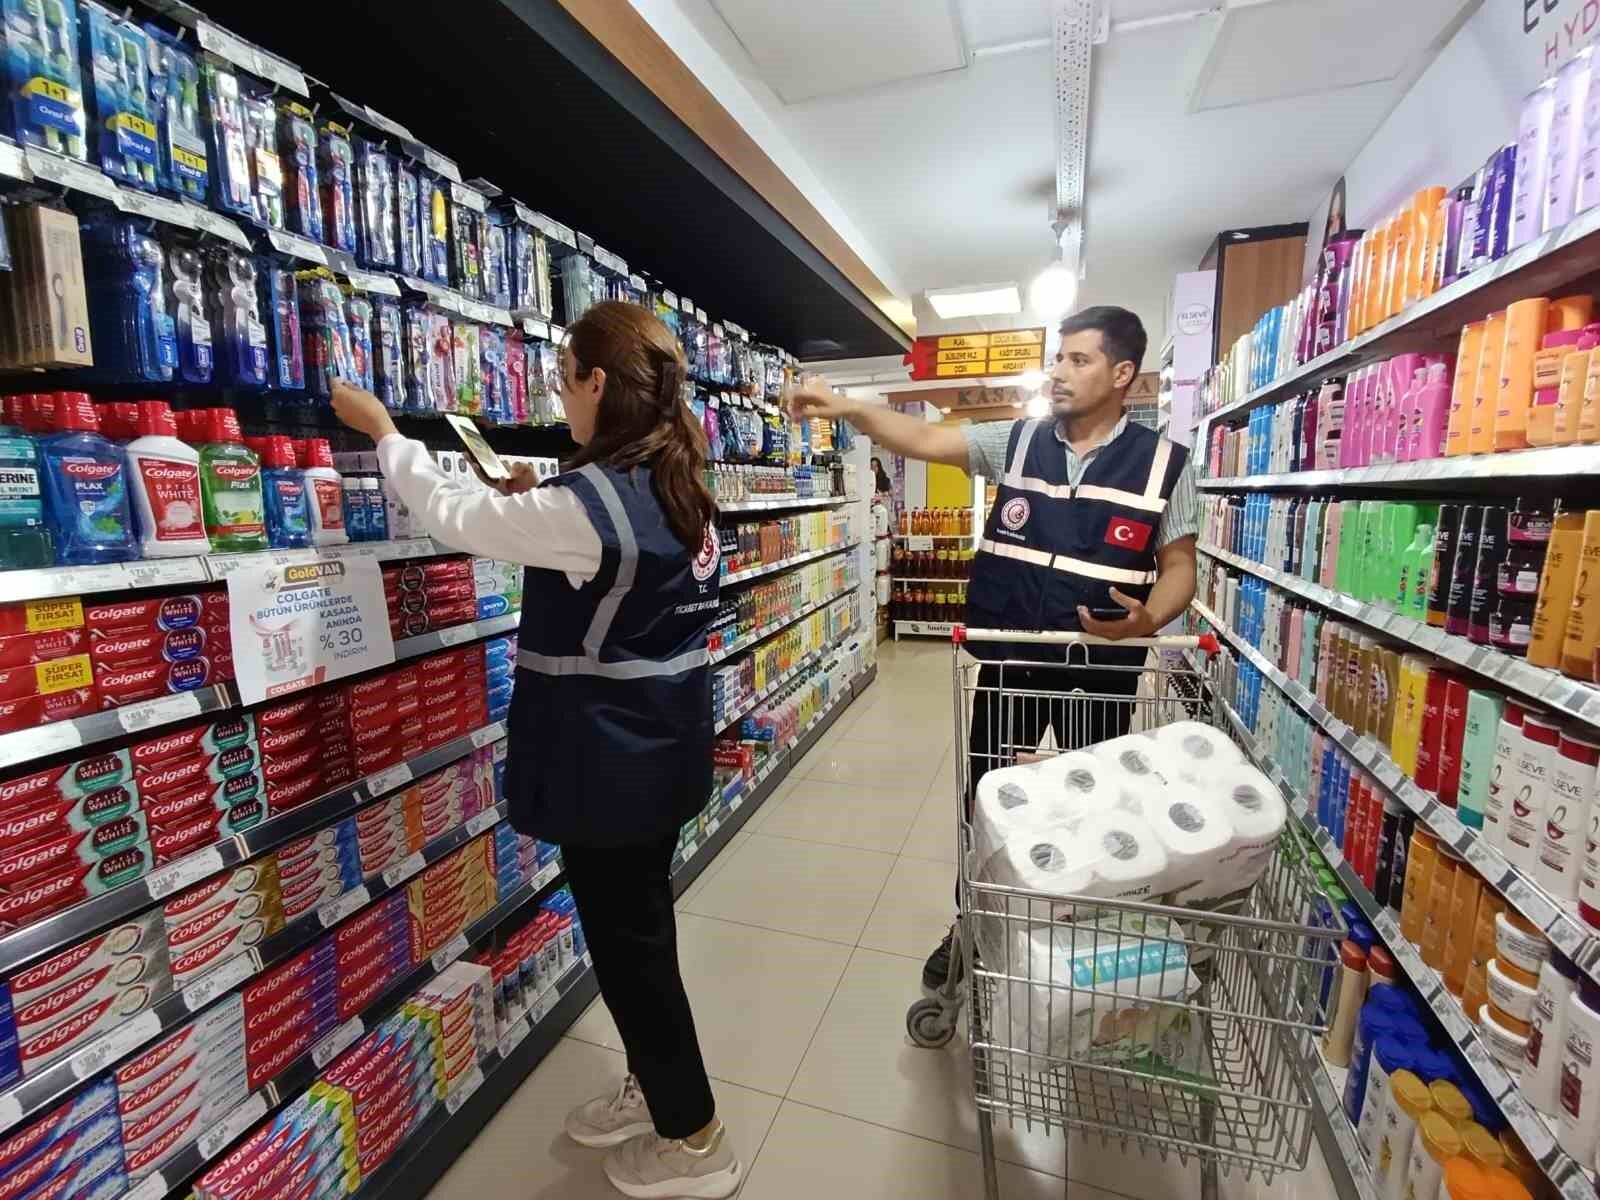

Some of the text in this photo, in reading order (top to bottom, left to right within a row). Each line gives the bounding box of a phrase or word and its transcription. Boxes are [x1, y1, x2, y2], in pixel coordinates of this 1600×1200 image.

[41, 81, 67, 100] 1+1
[129, 117, 146, 130] 1+1
[182, 152, 198, 167] 1+1
[67, 463, 113, 475] Colgate
[145, 467, 192, 478] Colgate
[216, 466, 256, 477] Colgate
[75, 482, 104, 490] PLAX
[157, 490, 194, 499] WHITE
[288, 563, 340, 580] GoldVAN
[276, 588, 332, 604] COLGATE
[36, 609, 75, 621] FIRSAT
[89, 605, 146, 620] Colgate
[165, 607, 193, 616] WHITE
[256, 594, 353, 620] BÜTÜN ÜRÜNLERDE
[320, 605, 360, 619] KASADA
[326, 616, 363, 630] ANINDA
[95, 637, 151, 654] Colgate
[169, 637, 197, 648] WHITE
[338, 628, 363, 647] 30
[46, 662, 83, 674] SÜPER
[46, 670, 84, 684] FIRSAT
[102, 669, 156, 687] Colgate
[174, 668, 202, 679] WHITE
[270, 680, 308, 695] COLGATE
[353, 678, 387, 693] Colgate
[262, 701, 305, 721] Colgate
[355, 701, 388, 718] Colgate
[216, 725, 243, 738] WHITE
[264, 727, 306, 748] Colgate
[356, 724, 391, 742] Colgate
[135, 733, 195, 758] Colgate
[222, 752, 249, 767] WHITE
[266, 752, 309, 775] Colgate
[358, 747, 392, 765] Colgate
[80, 762, 116, 779] WHITE
[142, 761, 201, 788] Colgate
[0, 775, 49, 800] lgate
[228, 779, 253, 793] WHITE
[270, 777, 312, 801] Colgate
[87, 795, 124, 811] WHITE
[151, 790, 208, 818] Colgate
[231, 807, 259, 822] WHITE
[97, 825, 133, 843] WHITE
[156, 819, 212, 848] Colgate
[103, 856, 139, 874] WHITE
[0, 875, 75, 912] Colgate
[164, 879, 222, 914] Colgate
[169, 905, 226, 943] Colgate
[338, 907, 384, 942] Colgate
[175, 935, 229, 972] Colgate
[340, 932, 385, 965] Colgate
[15, 944, 90, 989] Colgate
[342, 953, 385, 988] Colgate
[248, 960, 305, 1002] Colgate
[20, 975, 95, 1021] Colgate
[343, 973, 388, 1011] Colgate
[249, 985, 305, 1029] Colgate
[25, 1008, 99, 1055] Colgate
[250, 1011, 305, 1055] Colgate
[120, 1038, 182, 1080] Colgate
[253, 1034, 308, 1080] Colgate
[327, 1040, 374, 1080] Colgate
[345, 1045, 391, 1087] Colgate
[357, 1051, 406, 1098] Colgate
[124, 1065, 185, 1110] Colgate
[361, 1074, 410, 1121] Colgate
[127, 1092, 188, 1139] Colgate
[362, 1095, 411, 1146] Colgate
[130, 1120, 191, 1169] Colgate
[364, 1116, 412, 1169] Colgate
[202, 1129, 268, 1185] Colgate
[220, 1137, 285, 1193] Colgate
